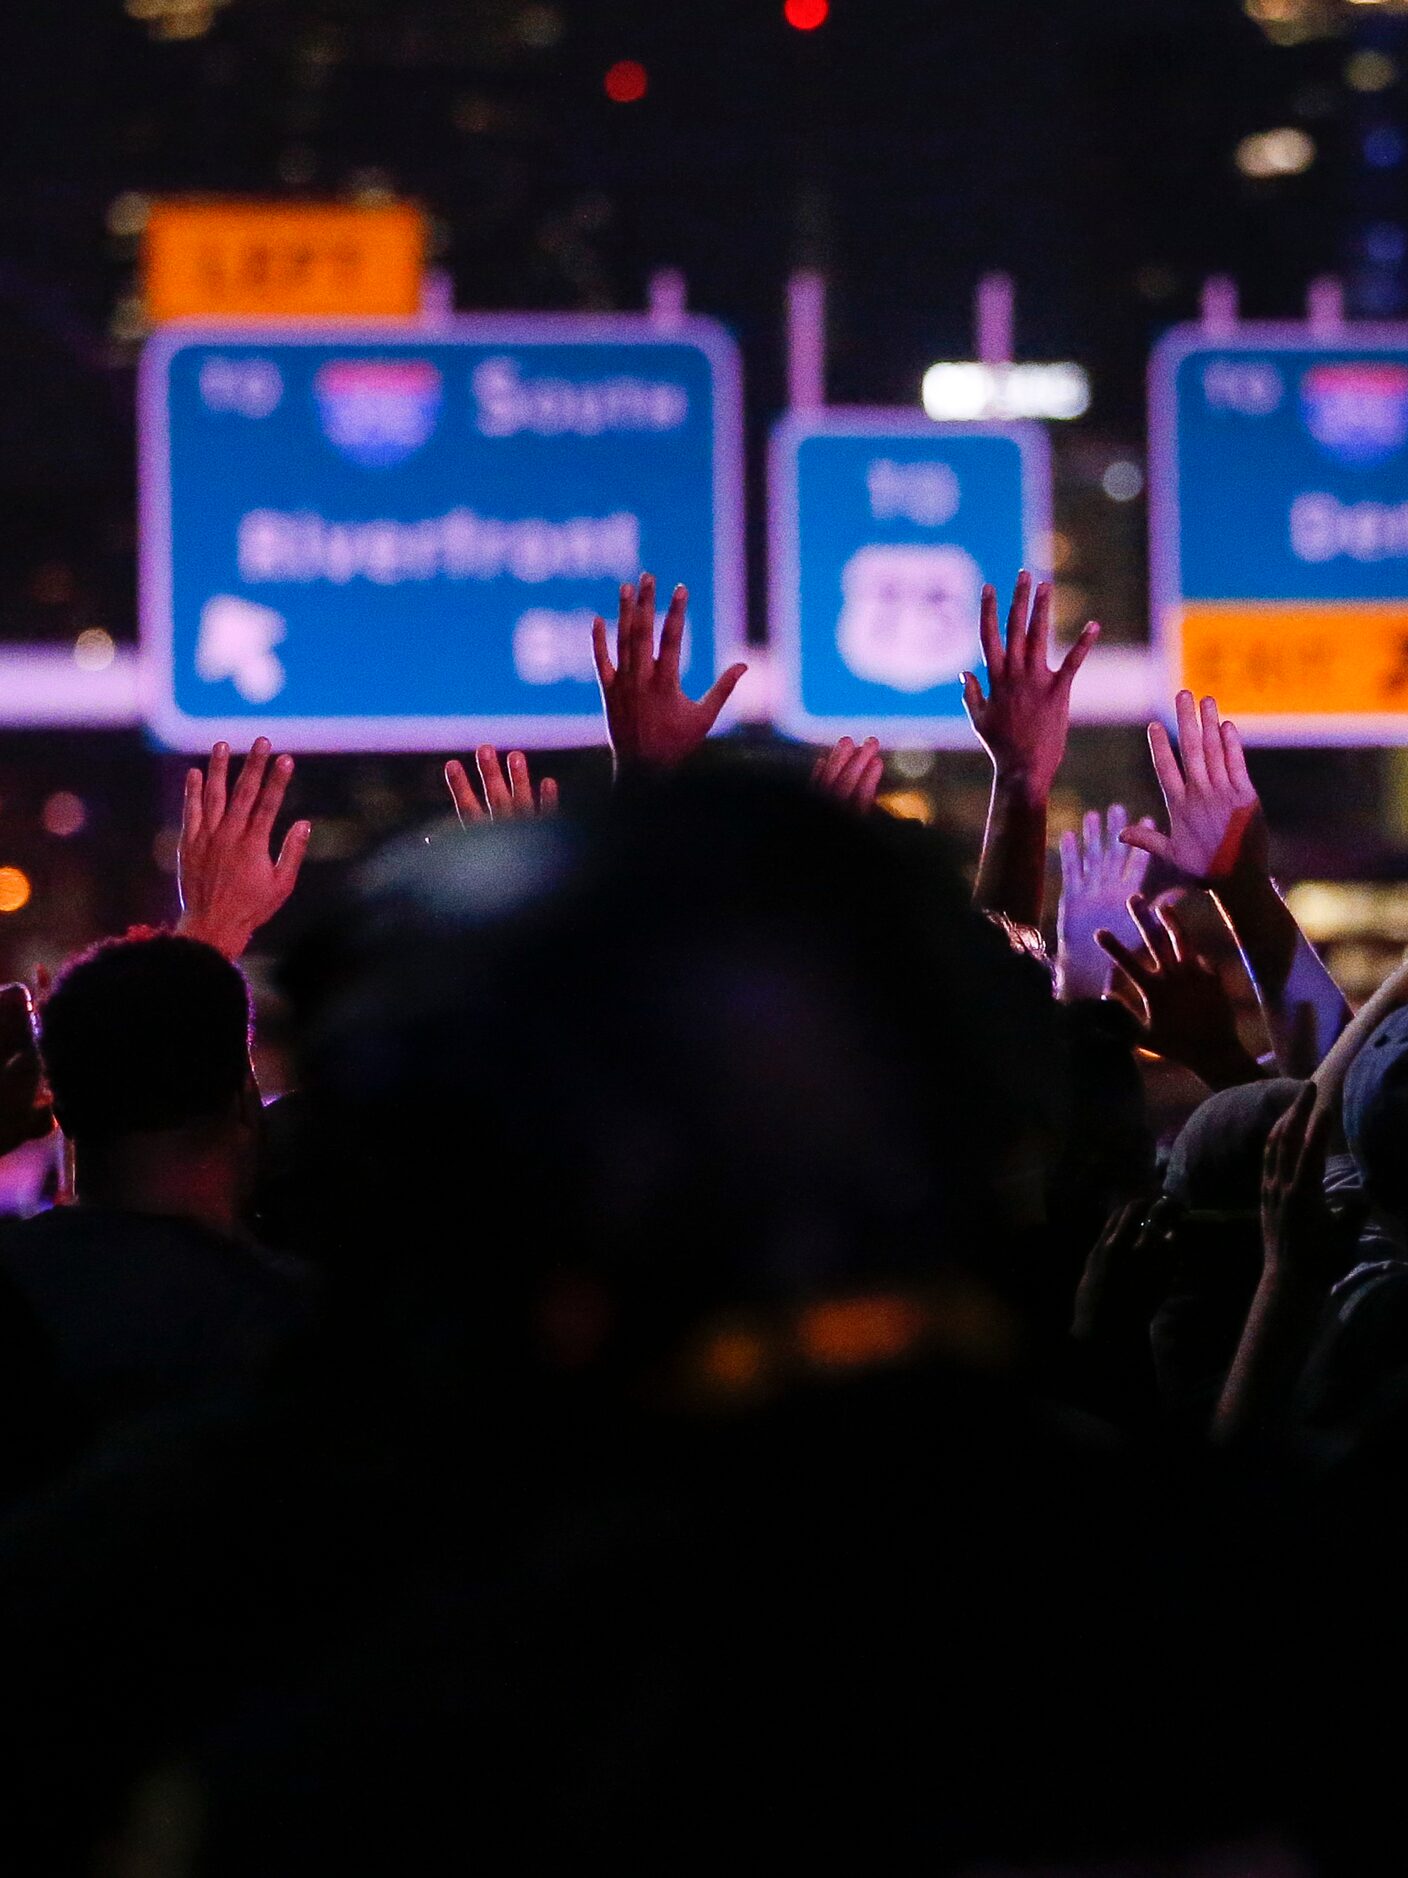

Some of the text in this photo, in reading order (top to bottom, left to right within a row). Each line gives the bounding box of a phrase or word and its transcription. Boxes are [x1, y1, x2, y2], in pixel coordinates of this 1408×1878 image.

[201, 359, 284, 417] TO
[474, 357, 689, 436] South
[1203, 360, 1282, 414] TO
[238, 507, 640, 583] Riverfront
